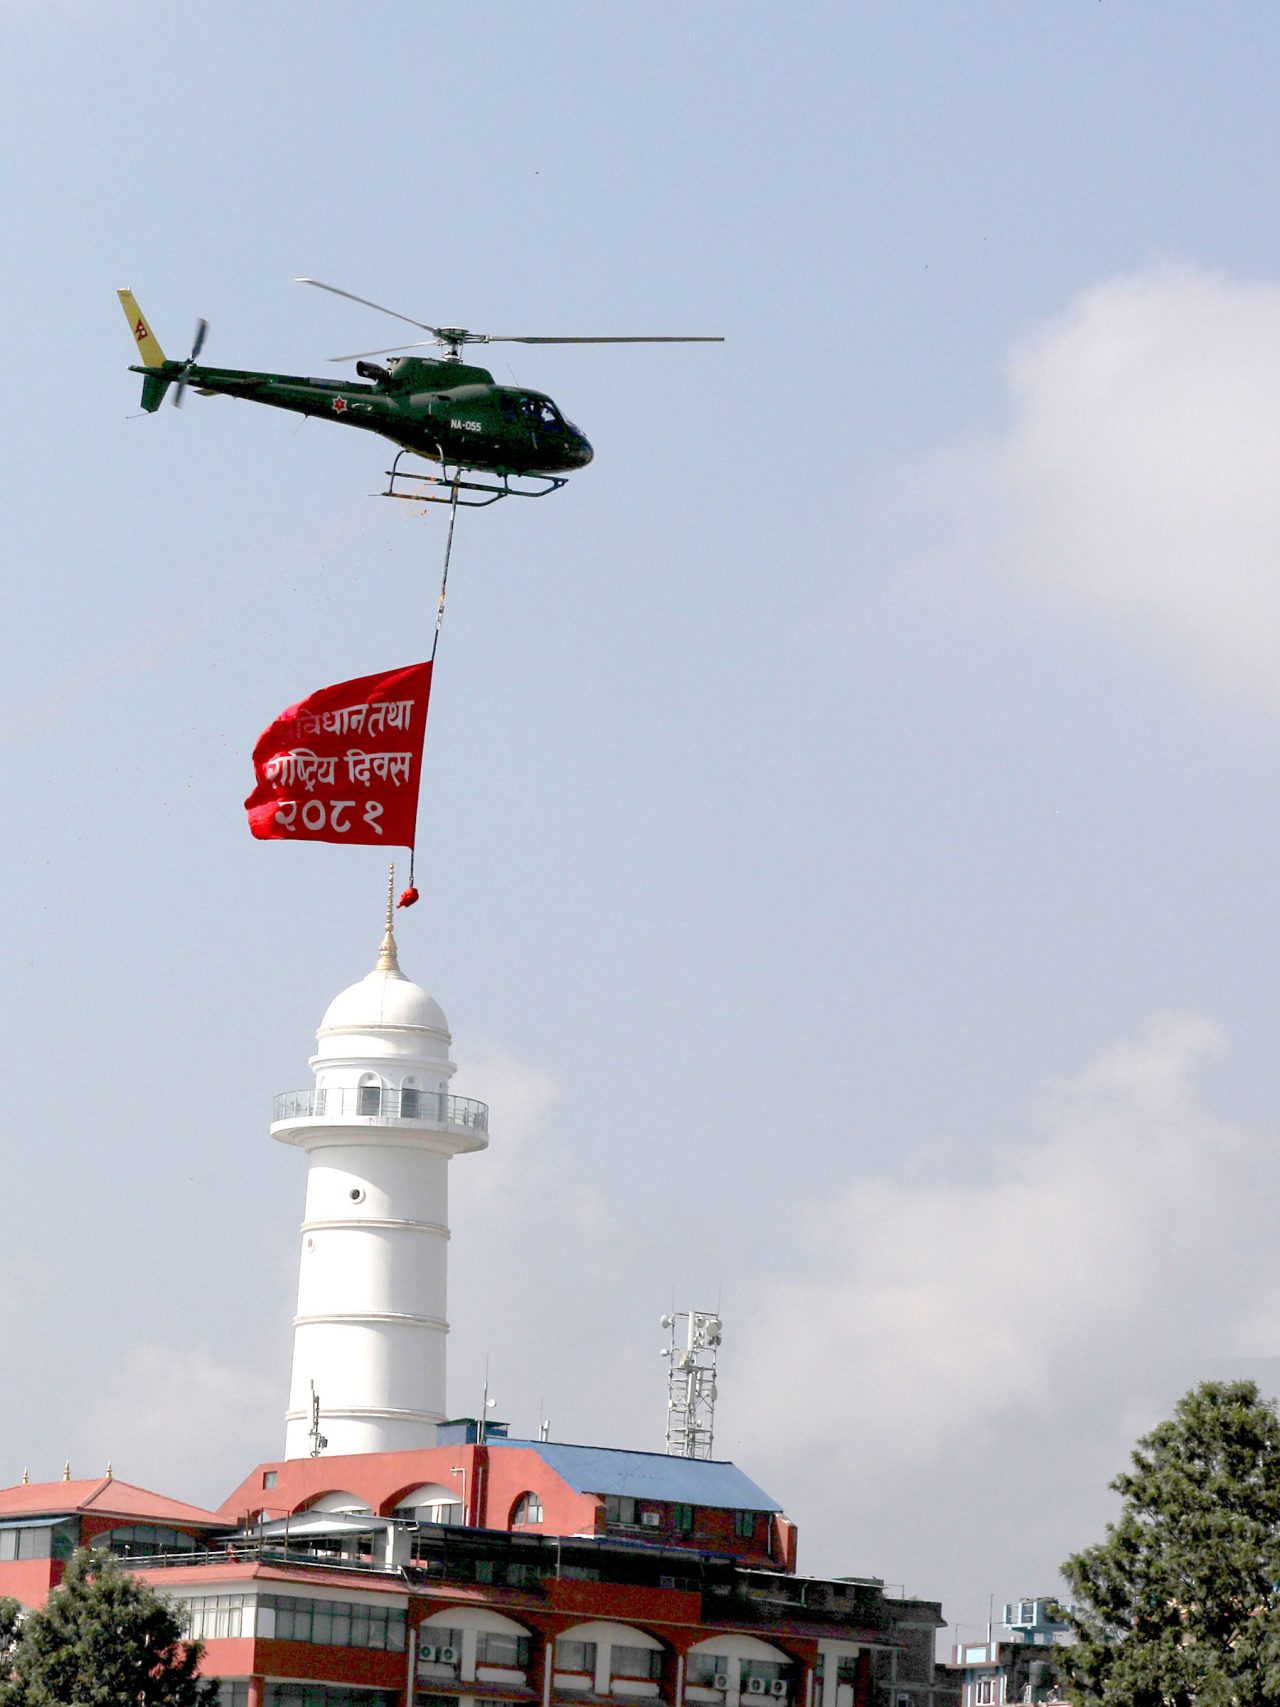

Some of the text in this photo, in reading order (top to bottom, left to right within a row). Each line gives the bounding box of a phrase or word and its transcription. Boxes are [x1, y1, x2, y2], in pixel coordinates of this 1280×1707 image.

[451, 419, 481, 431] NA-055
[369, 700, 415, 737] तथा
[343, 748, 414, 787] दिवस
[274, 799, 385, 835] २०८१
